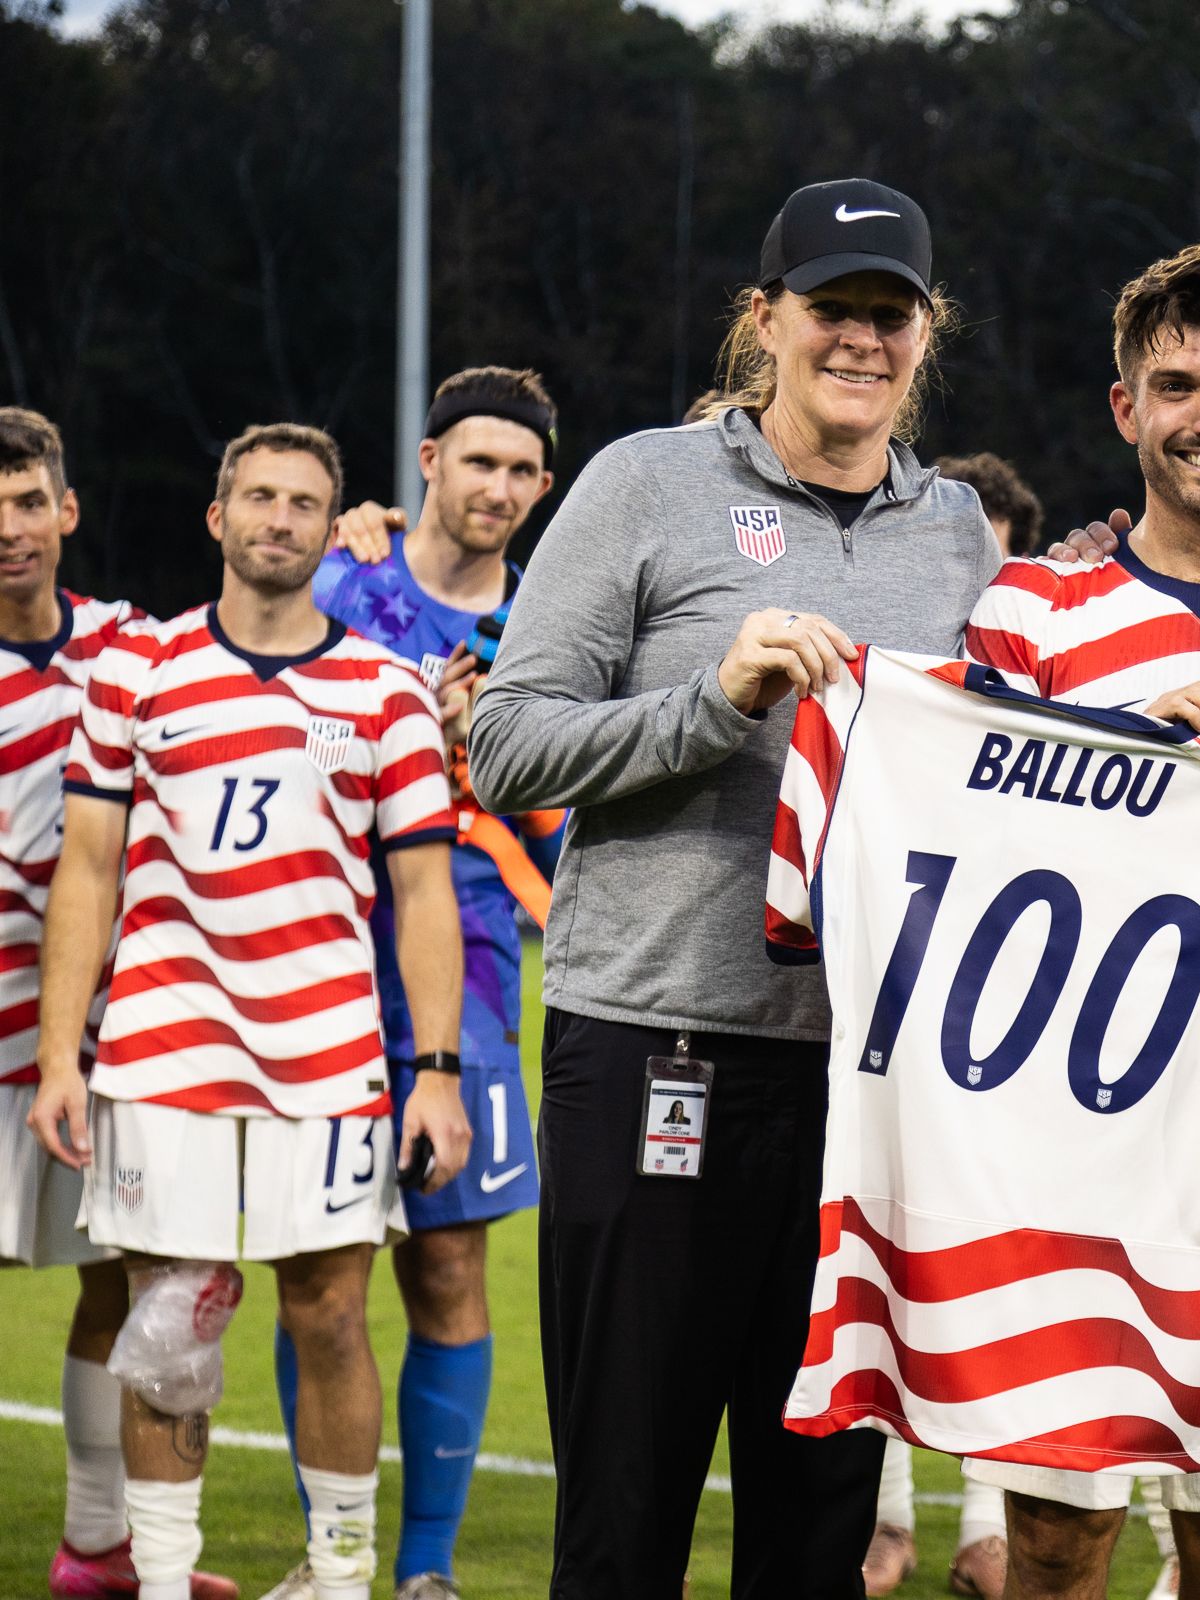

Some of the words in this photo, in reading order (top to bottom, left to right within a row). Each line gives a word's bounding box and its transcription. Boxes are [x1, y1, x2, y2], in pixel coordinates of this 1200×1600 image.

[734, 510, 778, 531] USA
[312, 720, 350, 741] USA
[967, 732, 1177, 817] BALLOU
[209, 777, 281, 851] 13
[324, 1115, 376, 1188] 13
[487, 1082, 508, 1164] 1
[118, 1168, 142, 1186] USA
